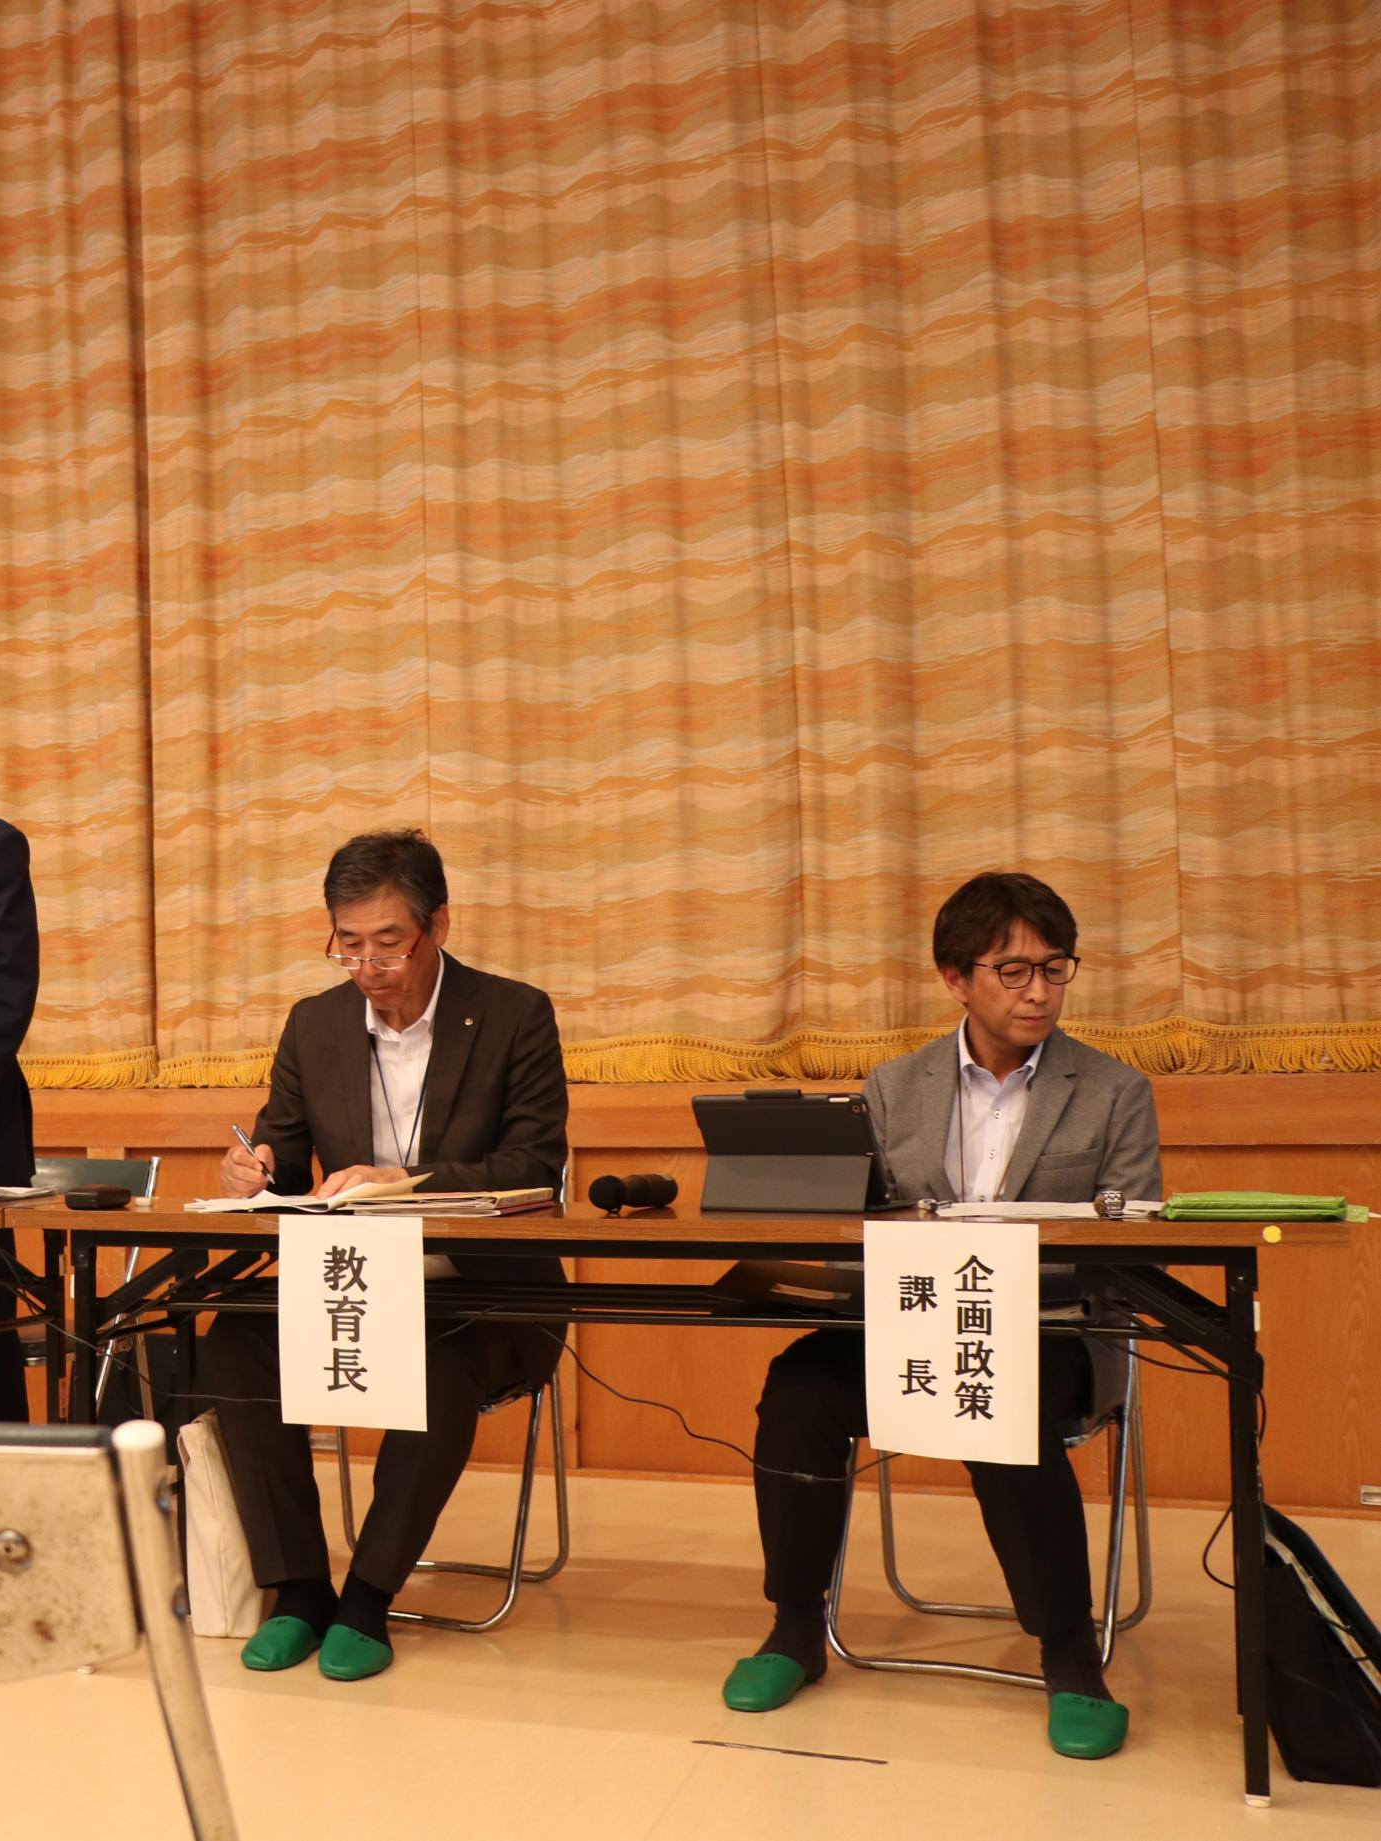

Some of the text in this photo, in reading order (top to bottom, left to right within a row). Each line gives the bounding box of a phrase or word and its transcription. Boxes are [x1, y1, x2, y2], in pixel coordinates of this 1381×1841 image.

[322, 1245, 369, 1394] 教育長
[898, 1275, 938, 1397] 課長
[953, 1254, 996, 1421] 企画政策
